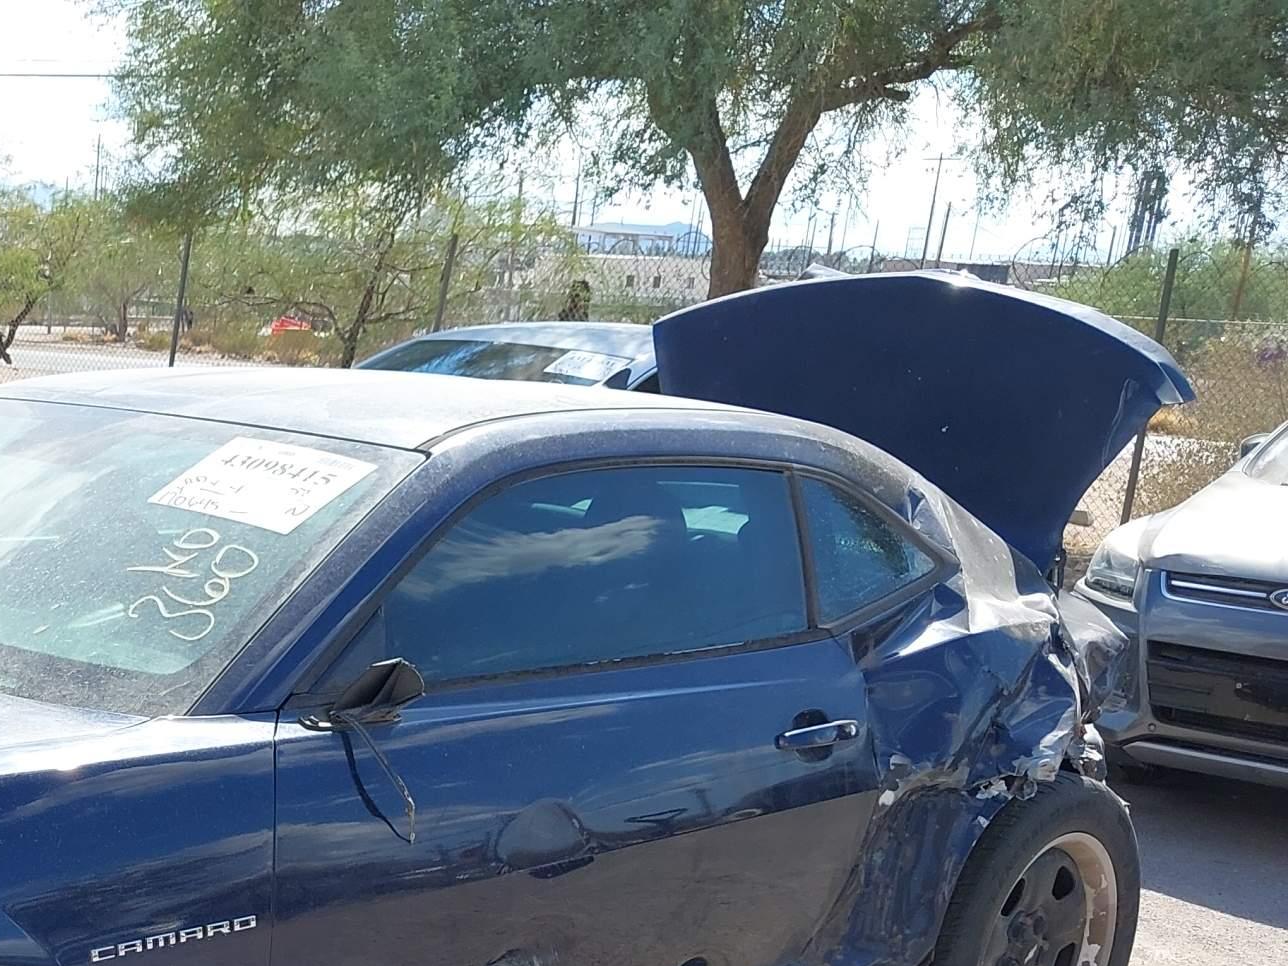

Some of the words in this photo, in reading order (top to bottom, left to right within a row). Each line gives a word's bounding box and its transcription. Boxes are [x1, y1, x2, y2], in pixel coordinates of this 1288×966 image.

[221, 454, 338, 486] 43098415
[128, 544, 259, 641] 360
[90, 914, 257, 963] CAMARO
